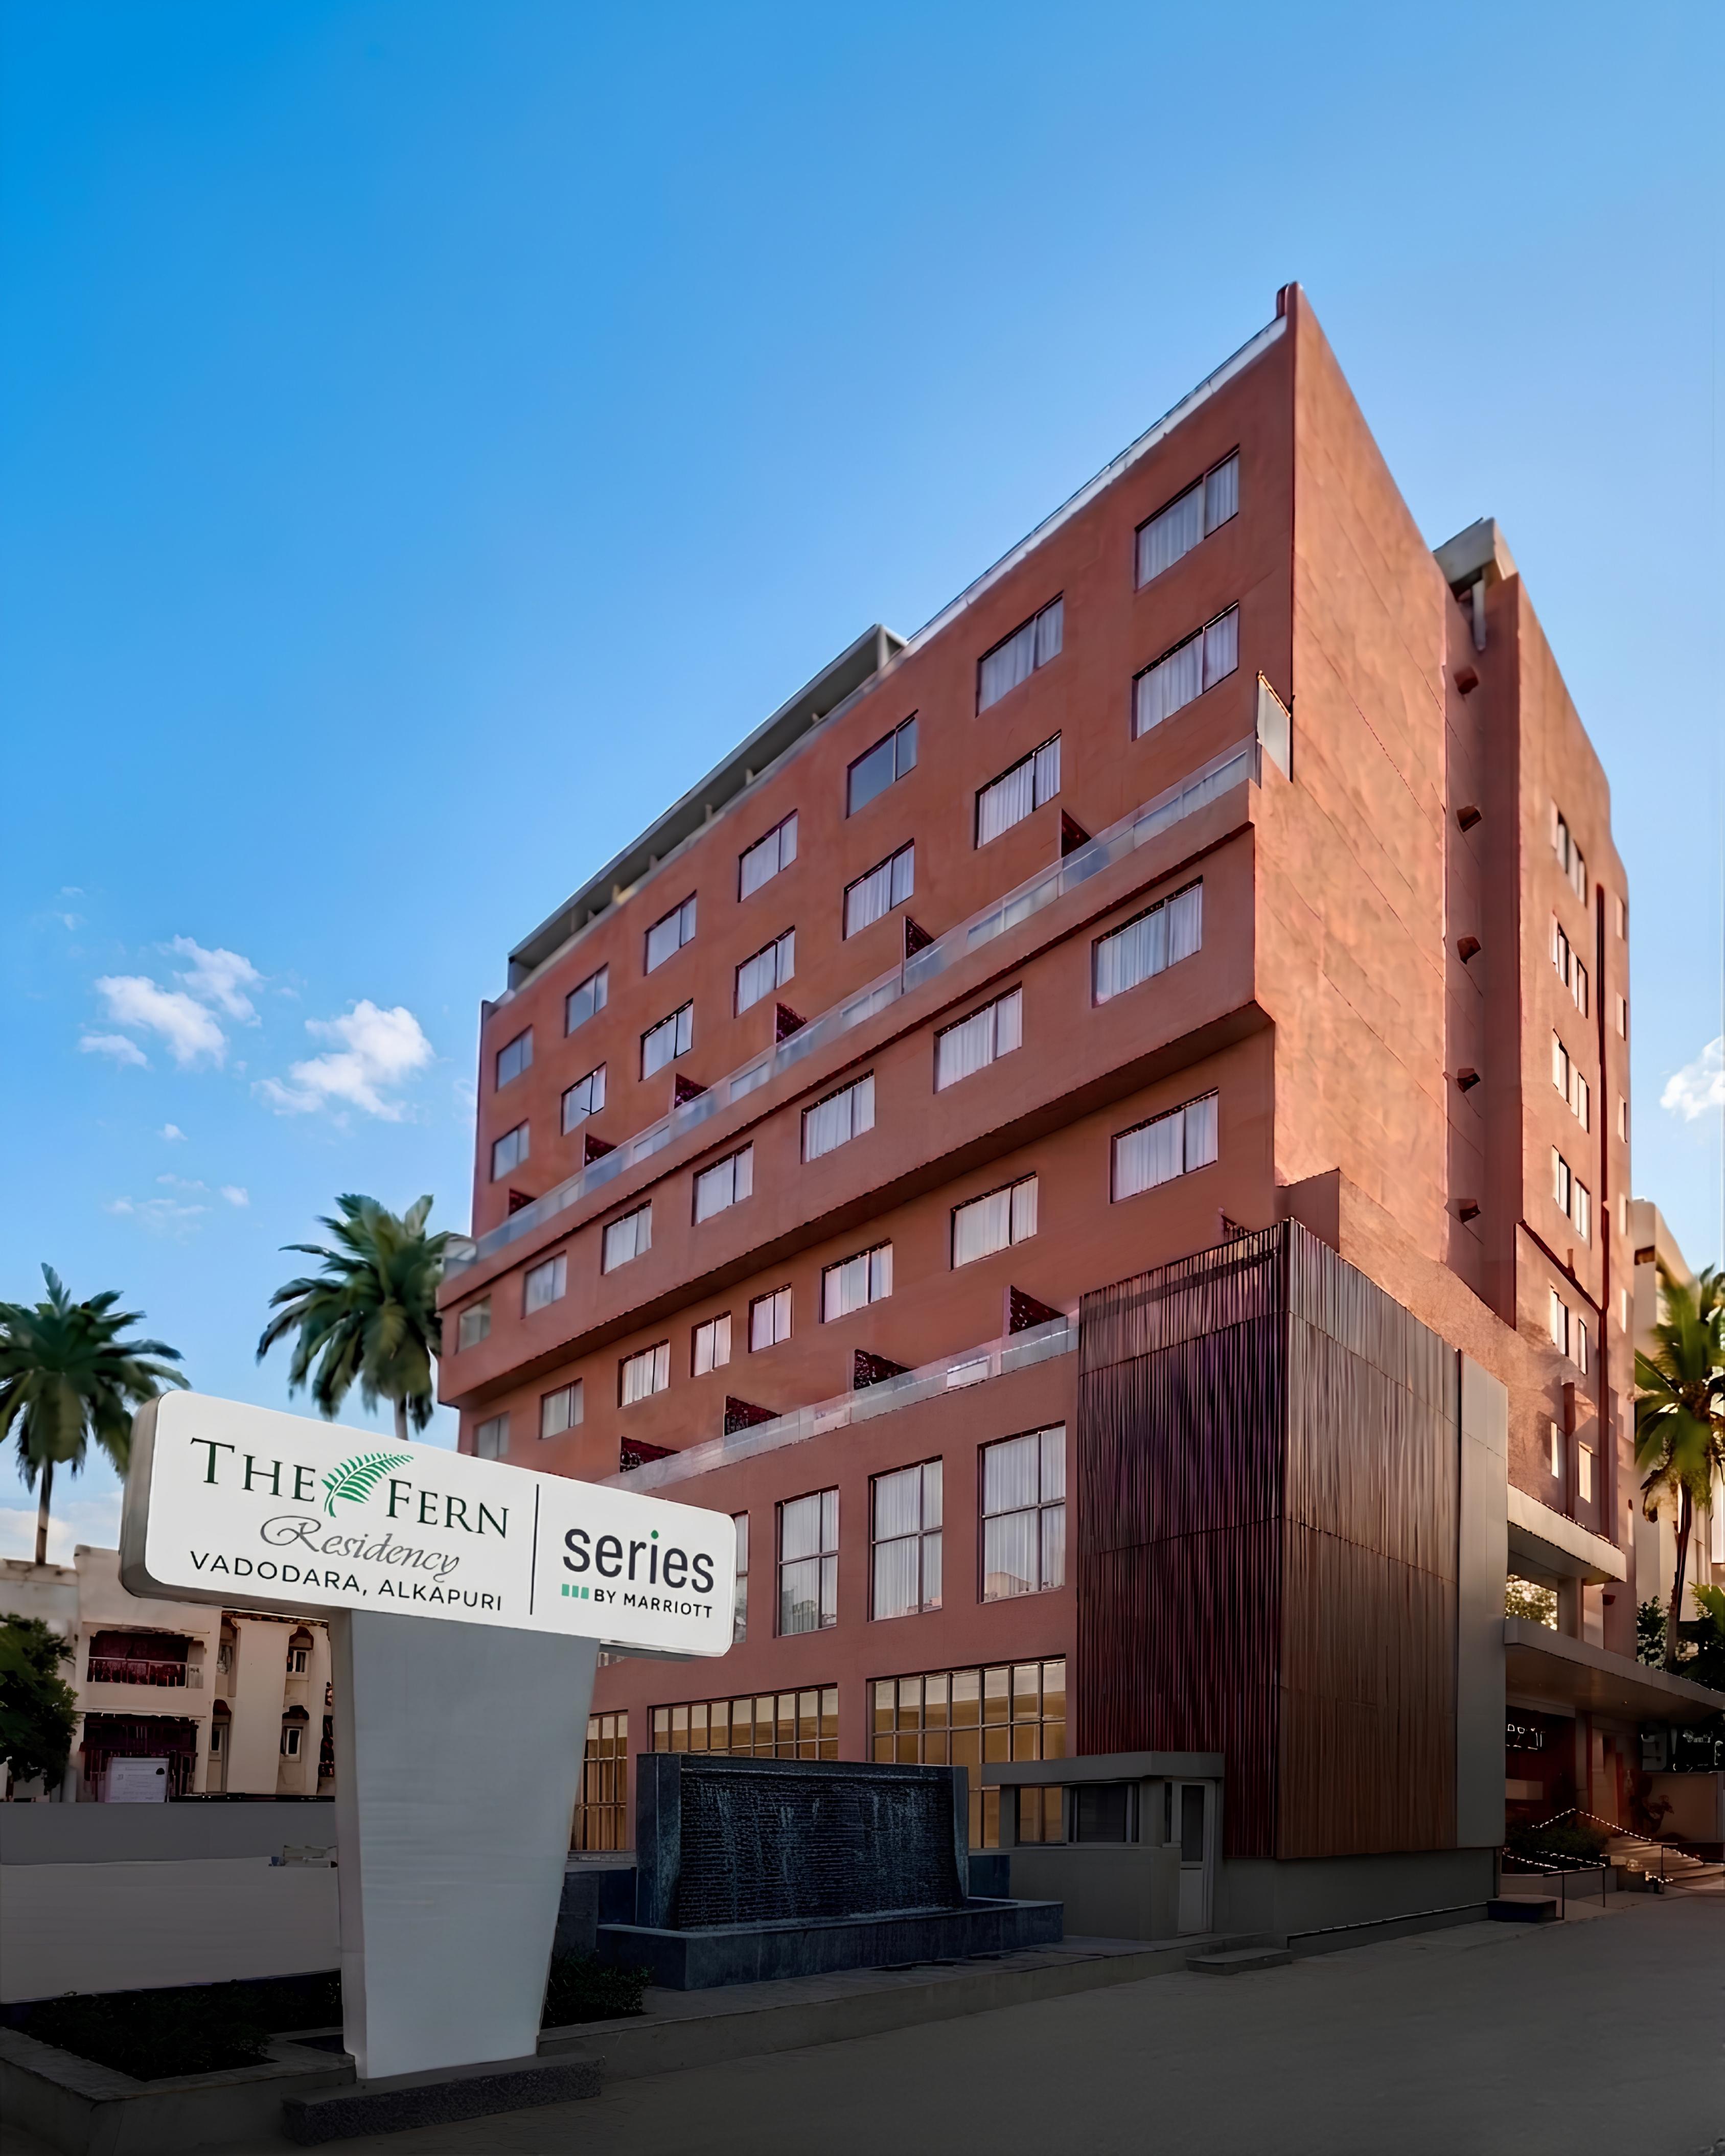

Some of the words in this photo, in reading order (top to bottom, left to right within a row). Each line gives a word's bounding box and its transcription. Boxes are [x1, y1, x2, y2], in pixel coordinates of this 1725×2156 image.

[190, 1436, 316, 1503] THE
[385, 1478, 510, 1539] FERN
[189, 1550, 367, 1597] VADODARA,
[377, 1579, 501, 1612] ALKAPURI
[259, 1515, 460, 1584] Residency
[562, 1528, 715, 1594] series
[593, 1588, 617, 1605] BY
[623, 1592, 713, 1619] MARRIOTT
